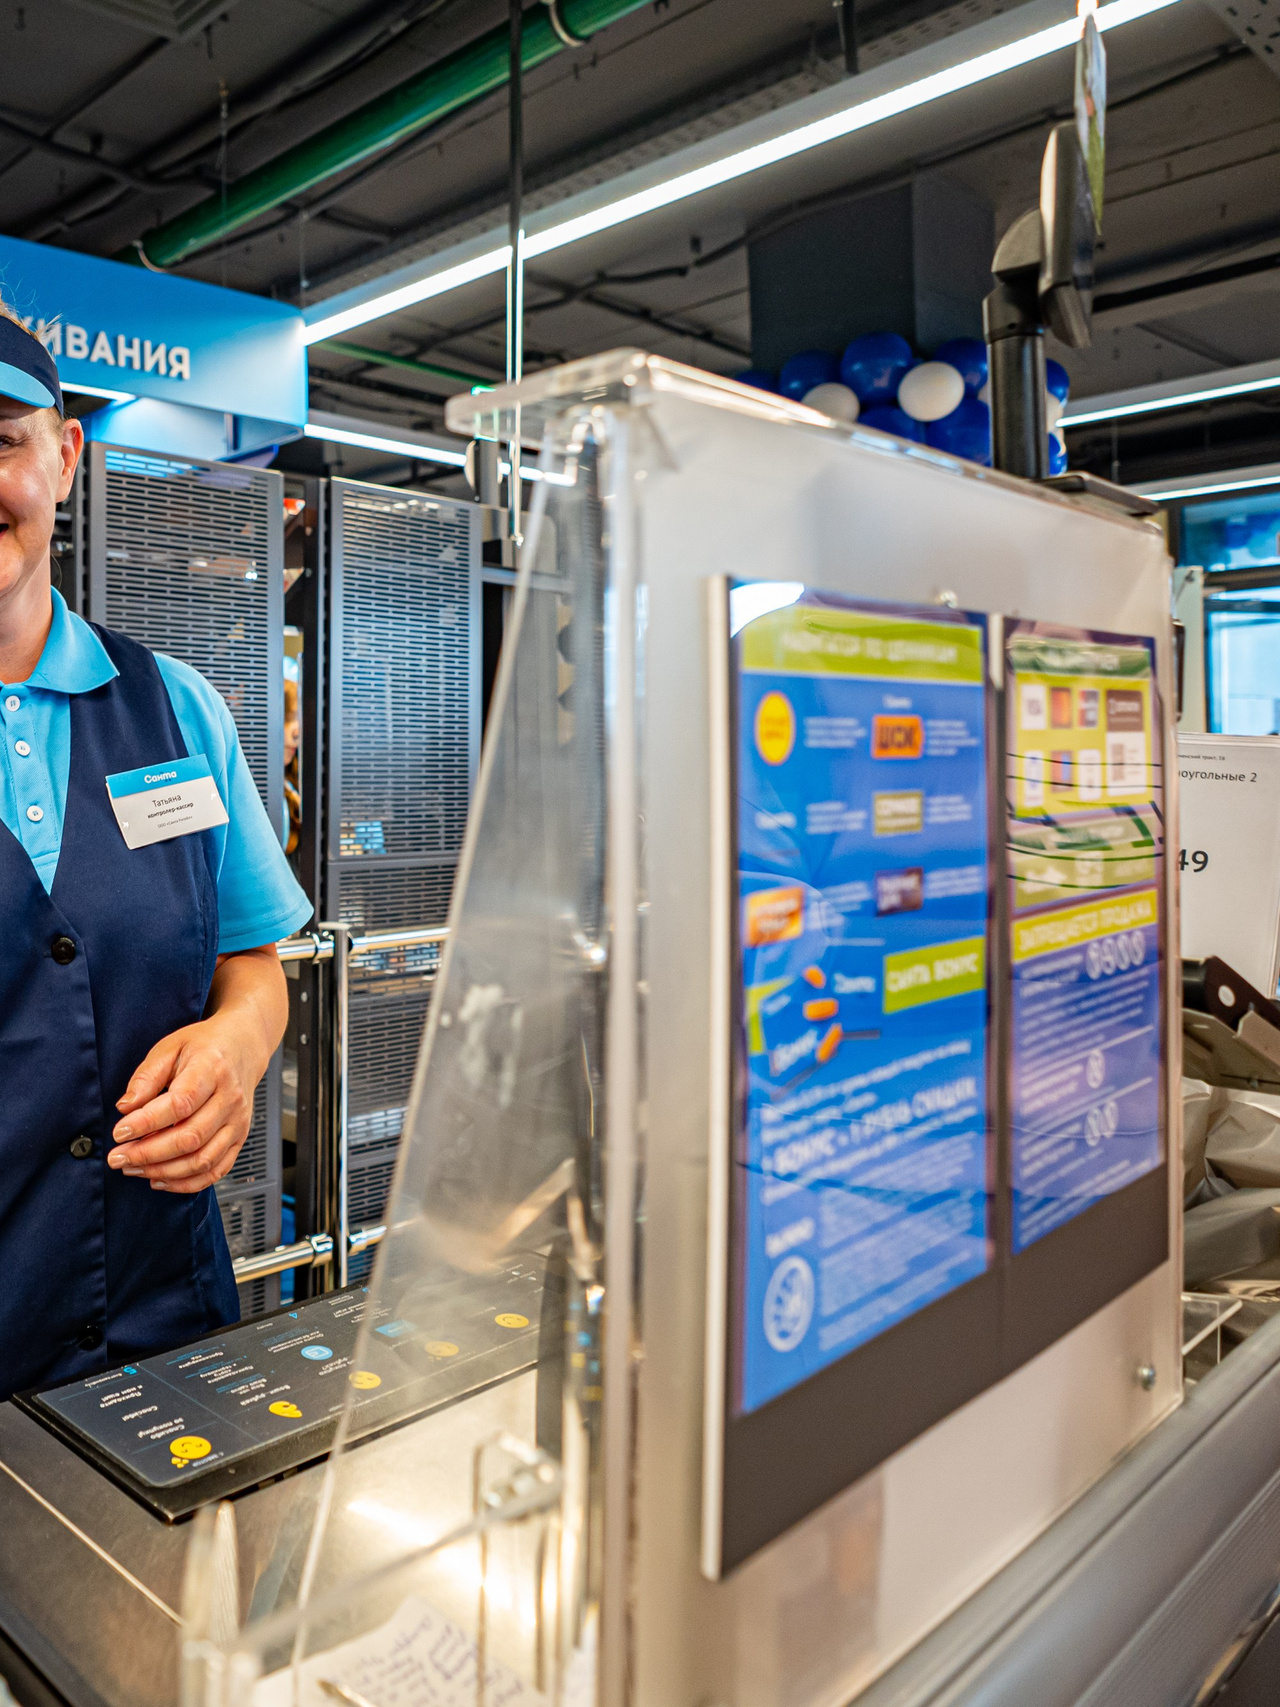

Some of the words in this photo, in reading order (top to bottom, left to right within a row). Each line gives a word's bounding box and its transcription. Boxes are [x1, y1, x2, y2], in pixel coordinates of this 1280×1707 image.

[144, 771, 177, 784] Санта
[1250, 772, 1258, 783] 2
[152, 795, 182, 808] Татьяна
[123, 1366, 137, 1376] 5
[99, 1391, 142, 1408] Приходите
[121, 1404, 158, 1422] Спасибо!
[150, 1424, 185, 1440] Спасибо
